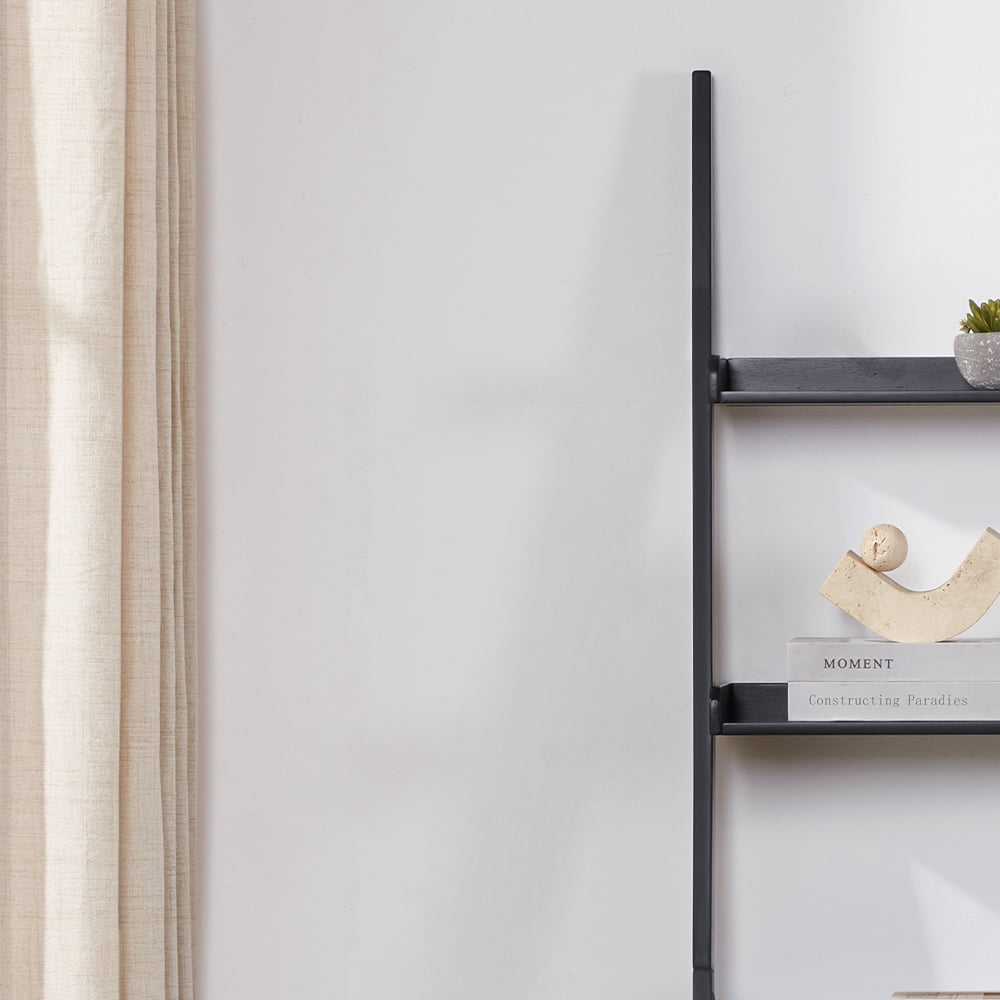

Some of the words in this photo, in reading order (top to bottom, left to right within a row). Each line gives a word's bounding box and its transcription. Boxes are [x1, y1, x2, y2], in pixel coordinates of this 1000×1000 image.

[823, 658, 895, 669] MOMENT
[808, 694, 901, 707] Constructing
[907, 694, 969, 706] Paradies
